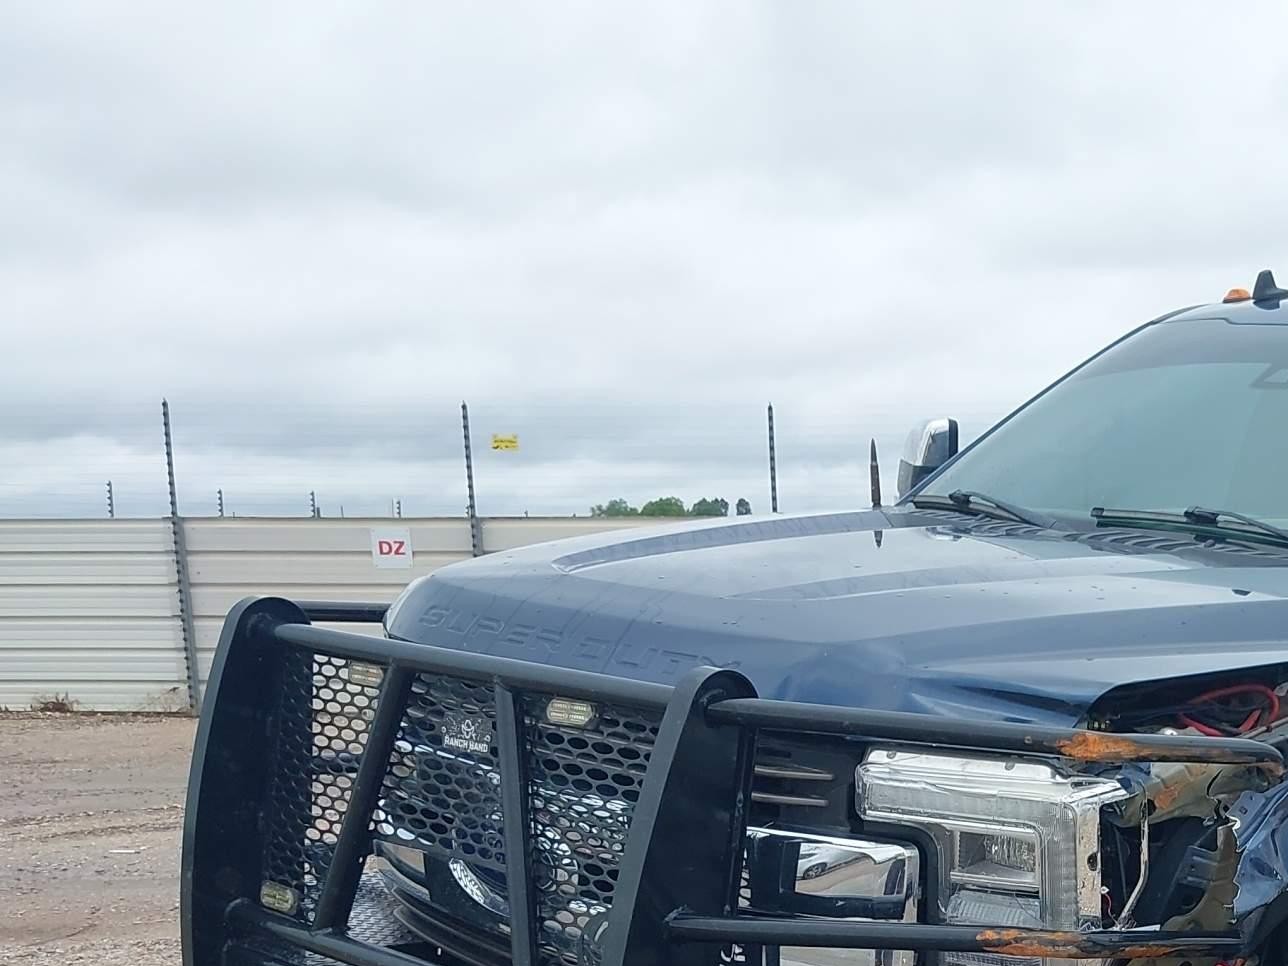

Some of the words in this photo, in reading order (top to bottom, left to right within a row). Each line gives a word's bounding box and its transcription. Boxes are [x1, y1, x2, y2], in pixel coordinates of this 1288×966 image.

[378, 540, 407, 556] DZ
[418, 604, 564, 654] SUPER
[444, 735, 468, 749] RANCH
